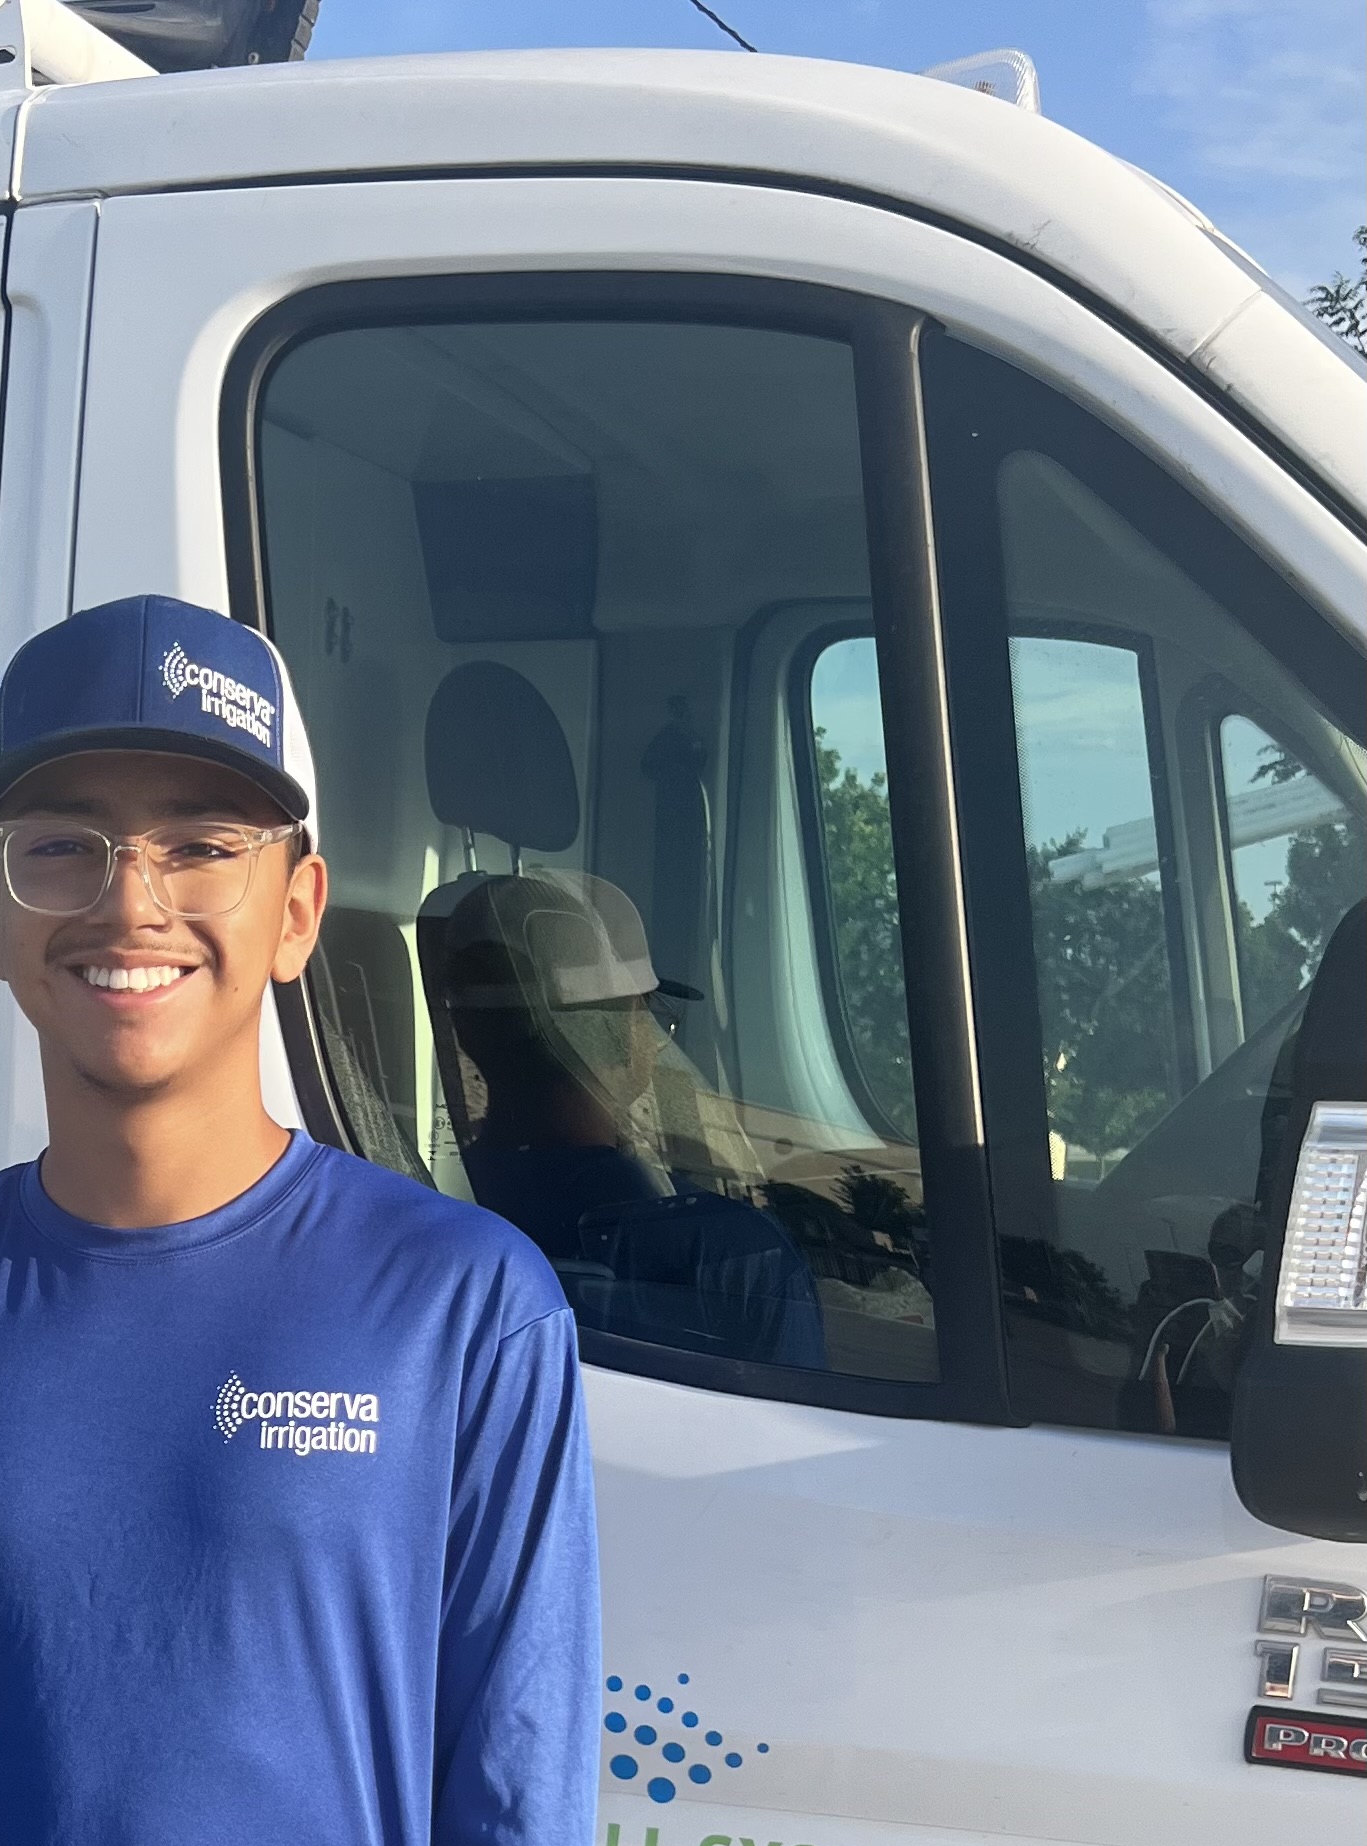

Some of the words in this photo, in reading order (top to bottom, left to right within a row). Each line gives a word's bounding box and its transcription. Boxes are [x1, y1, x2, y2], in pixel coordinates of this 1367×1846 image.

[185, 663, 272, 727] conserva
[200, 689, 271, 748] irrigation
[240, 1390, 380, 1422] conserva
[260, 1420, 377, 1457] irrigation
